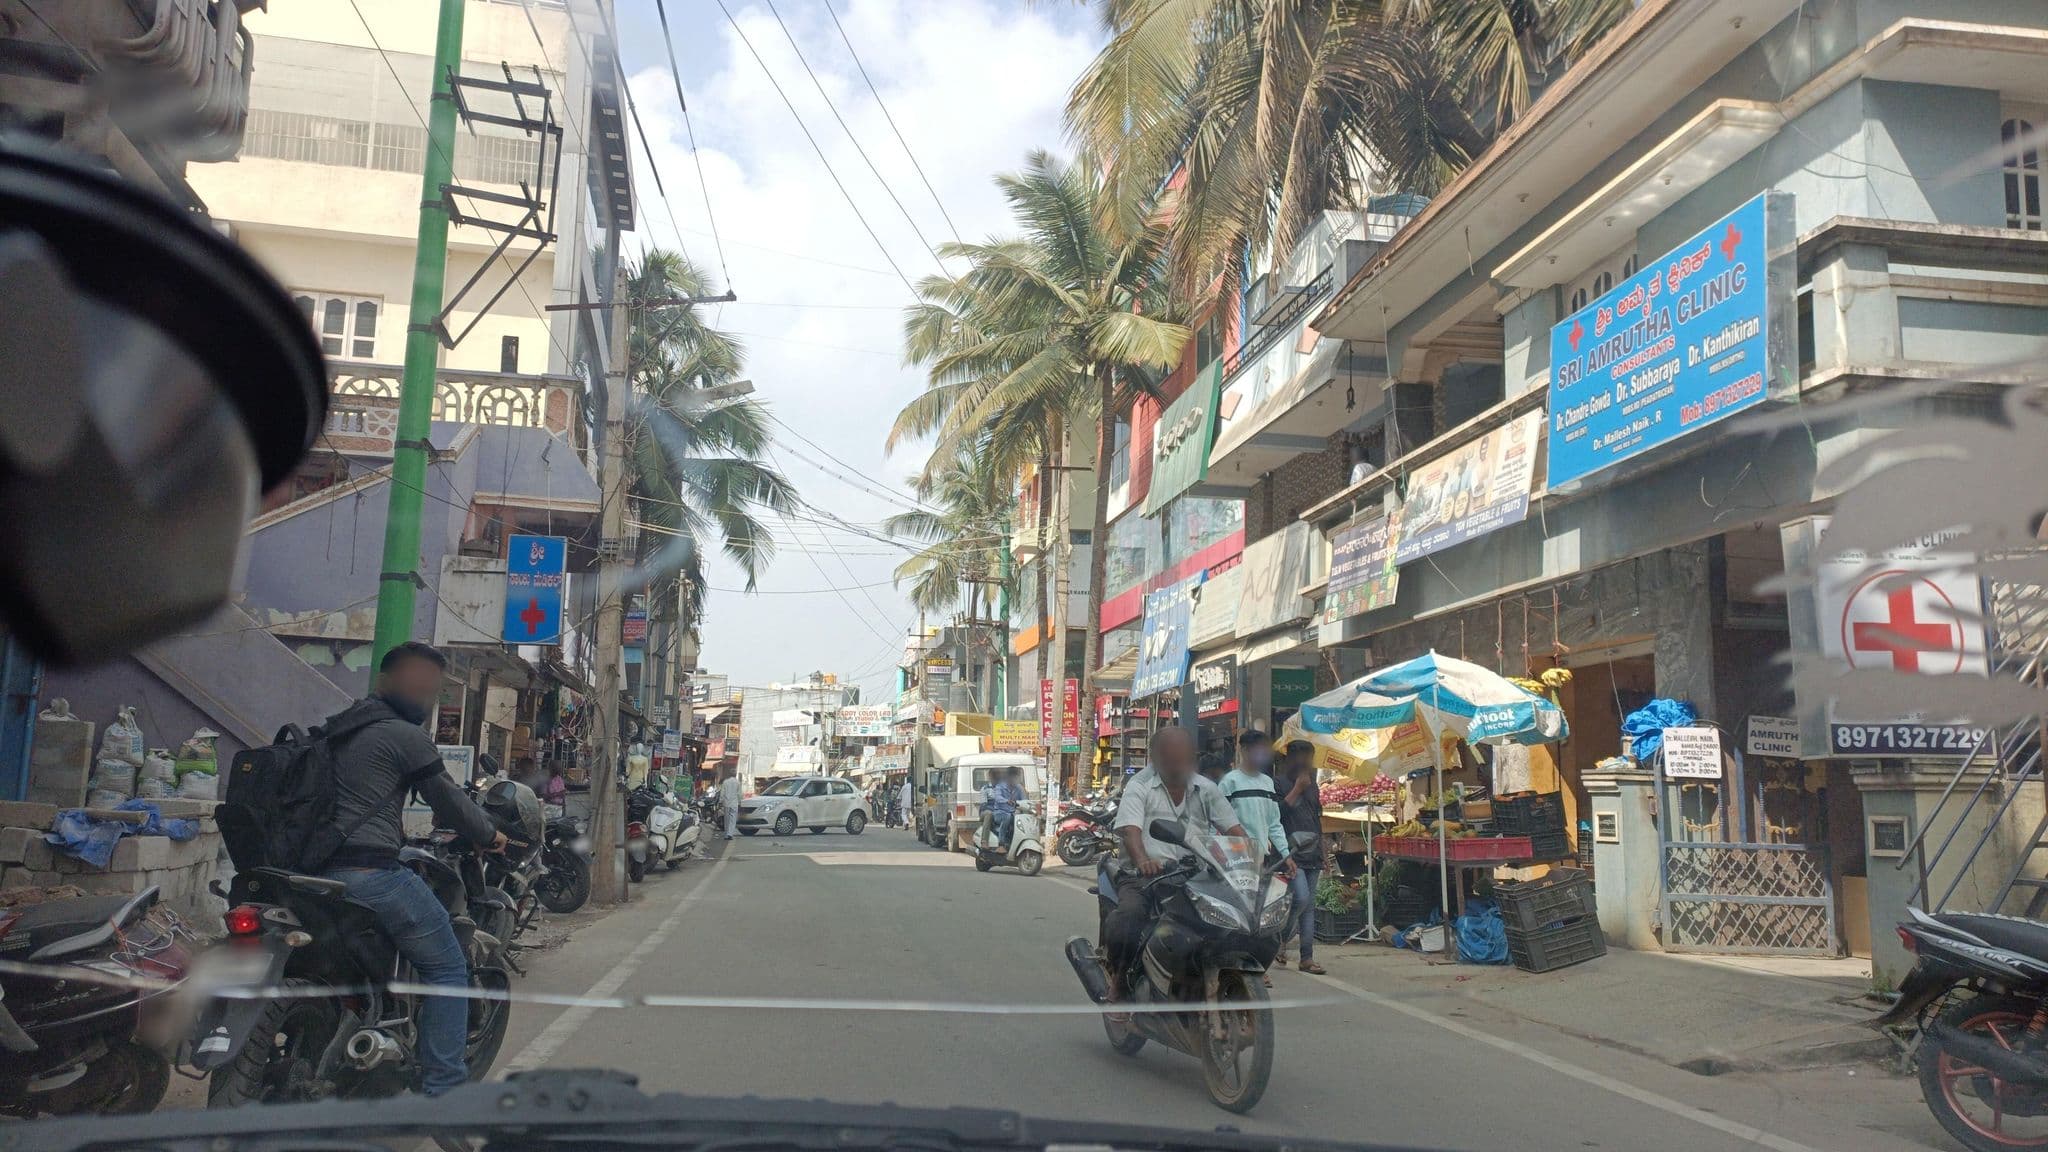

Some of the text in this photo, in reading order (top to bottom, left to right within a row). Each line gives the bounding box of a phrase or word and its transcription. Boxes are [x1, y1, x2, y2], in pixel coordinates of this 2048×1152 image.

[1557, 263, 1748, 391] SRI AMRUTHA CLINIC
[1595, 305, 1613, 338] ಶ್ರೀ
[1688, 316, 1760, 367] Dr. Kanthikiran
[1611, 337, 1675, 379] CONSULTANTS
[1616, 358, 1681, 404] Dr. Subbaraya
[1556, 413, 1564, 432] Dr.
[1590, 389, 1611, 415] Gowda
[1680, 401, 1702, 427] Mob:
[1593, 439, 1603, 451] Dr.
[1604, 423, 1631, 446] Mallesh
[1632, 416, 1649, 433] Naik
[1501, 498, 1521, 515] FRUITS
[529, 542, 545, 566] ಶ್ರೀ
[1485, 721, 1516, 731] INCORP
[1750, 729, 1799, 741] AMRUTH
[1837, 726, 1987, 748] 8971327229
[1753, 742, 1793, 752] CLINIC
